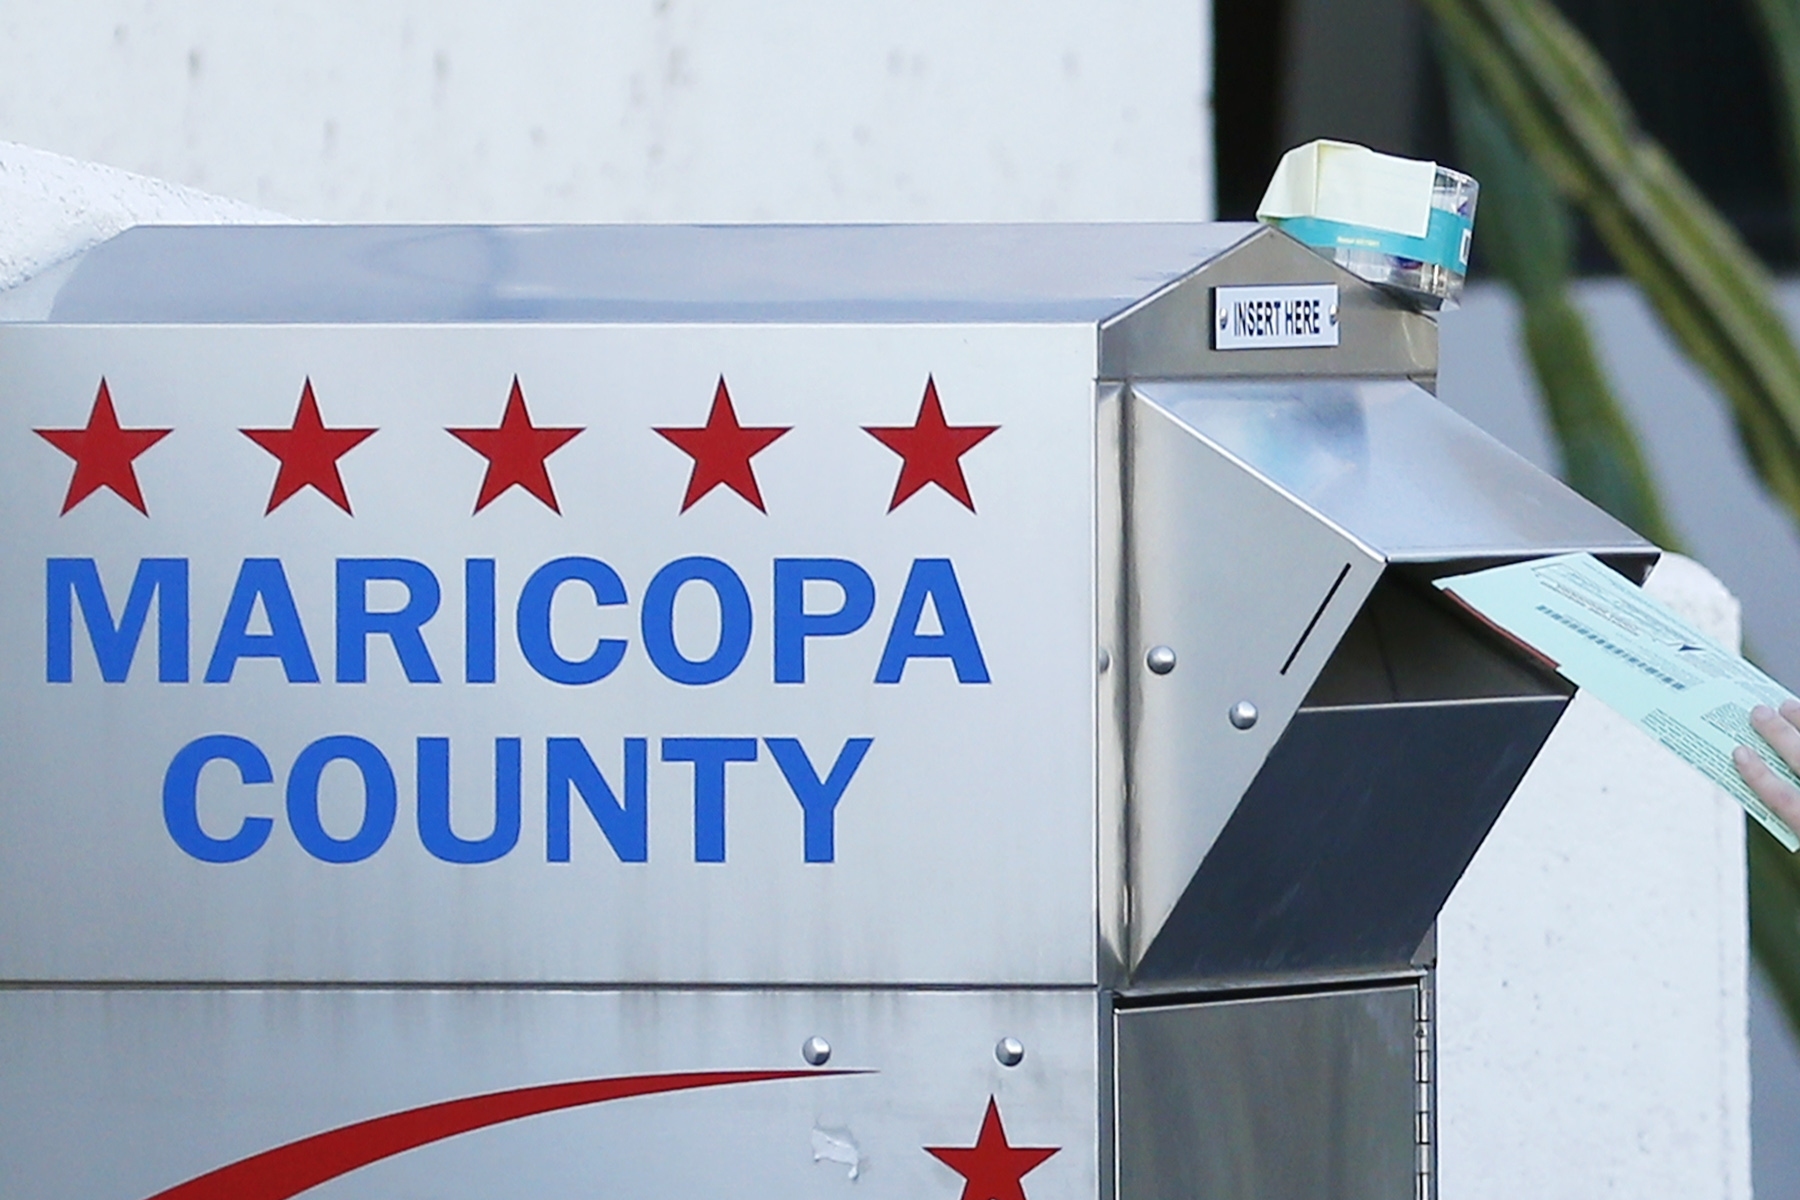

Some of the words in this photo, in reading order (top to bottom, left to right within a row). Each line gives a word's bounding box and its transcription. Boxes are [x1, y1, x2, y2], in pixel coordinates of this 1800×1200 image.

[1233, 301, 1281, 336] INSERT
[1284, 300, 1320, 335] HERE
[46, 556, 991, 686] MARICOPA
[162, 734, 874, 865] COUNTY
